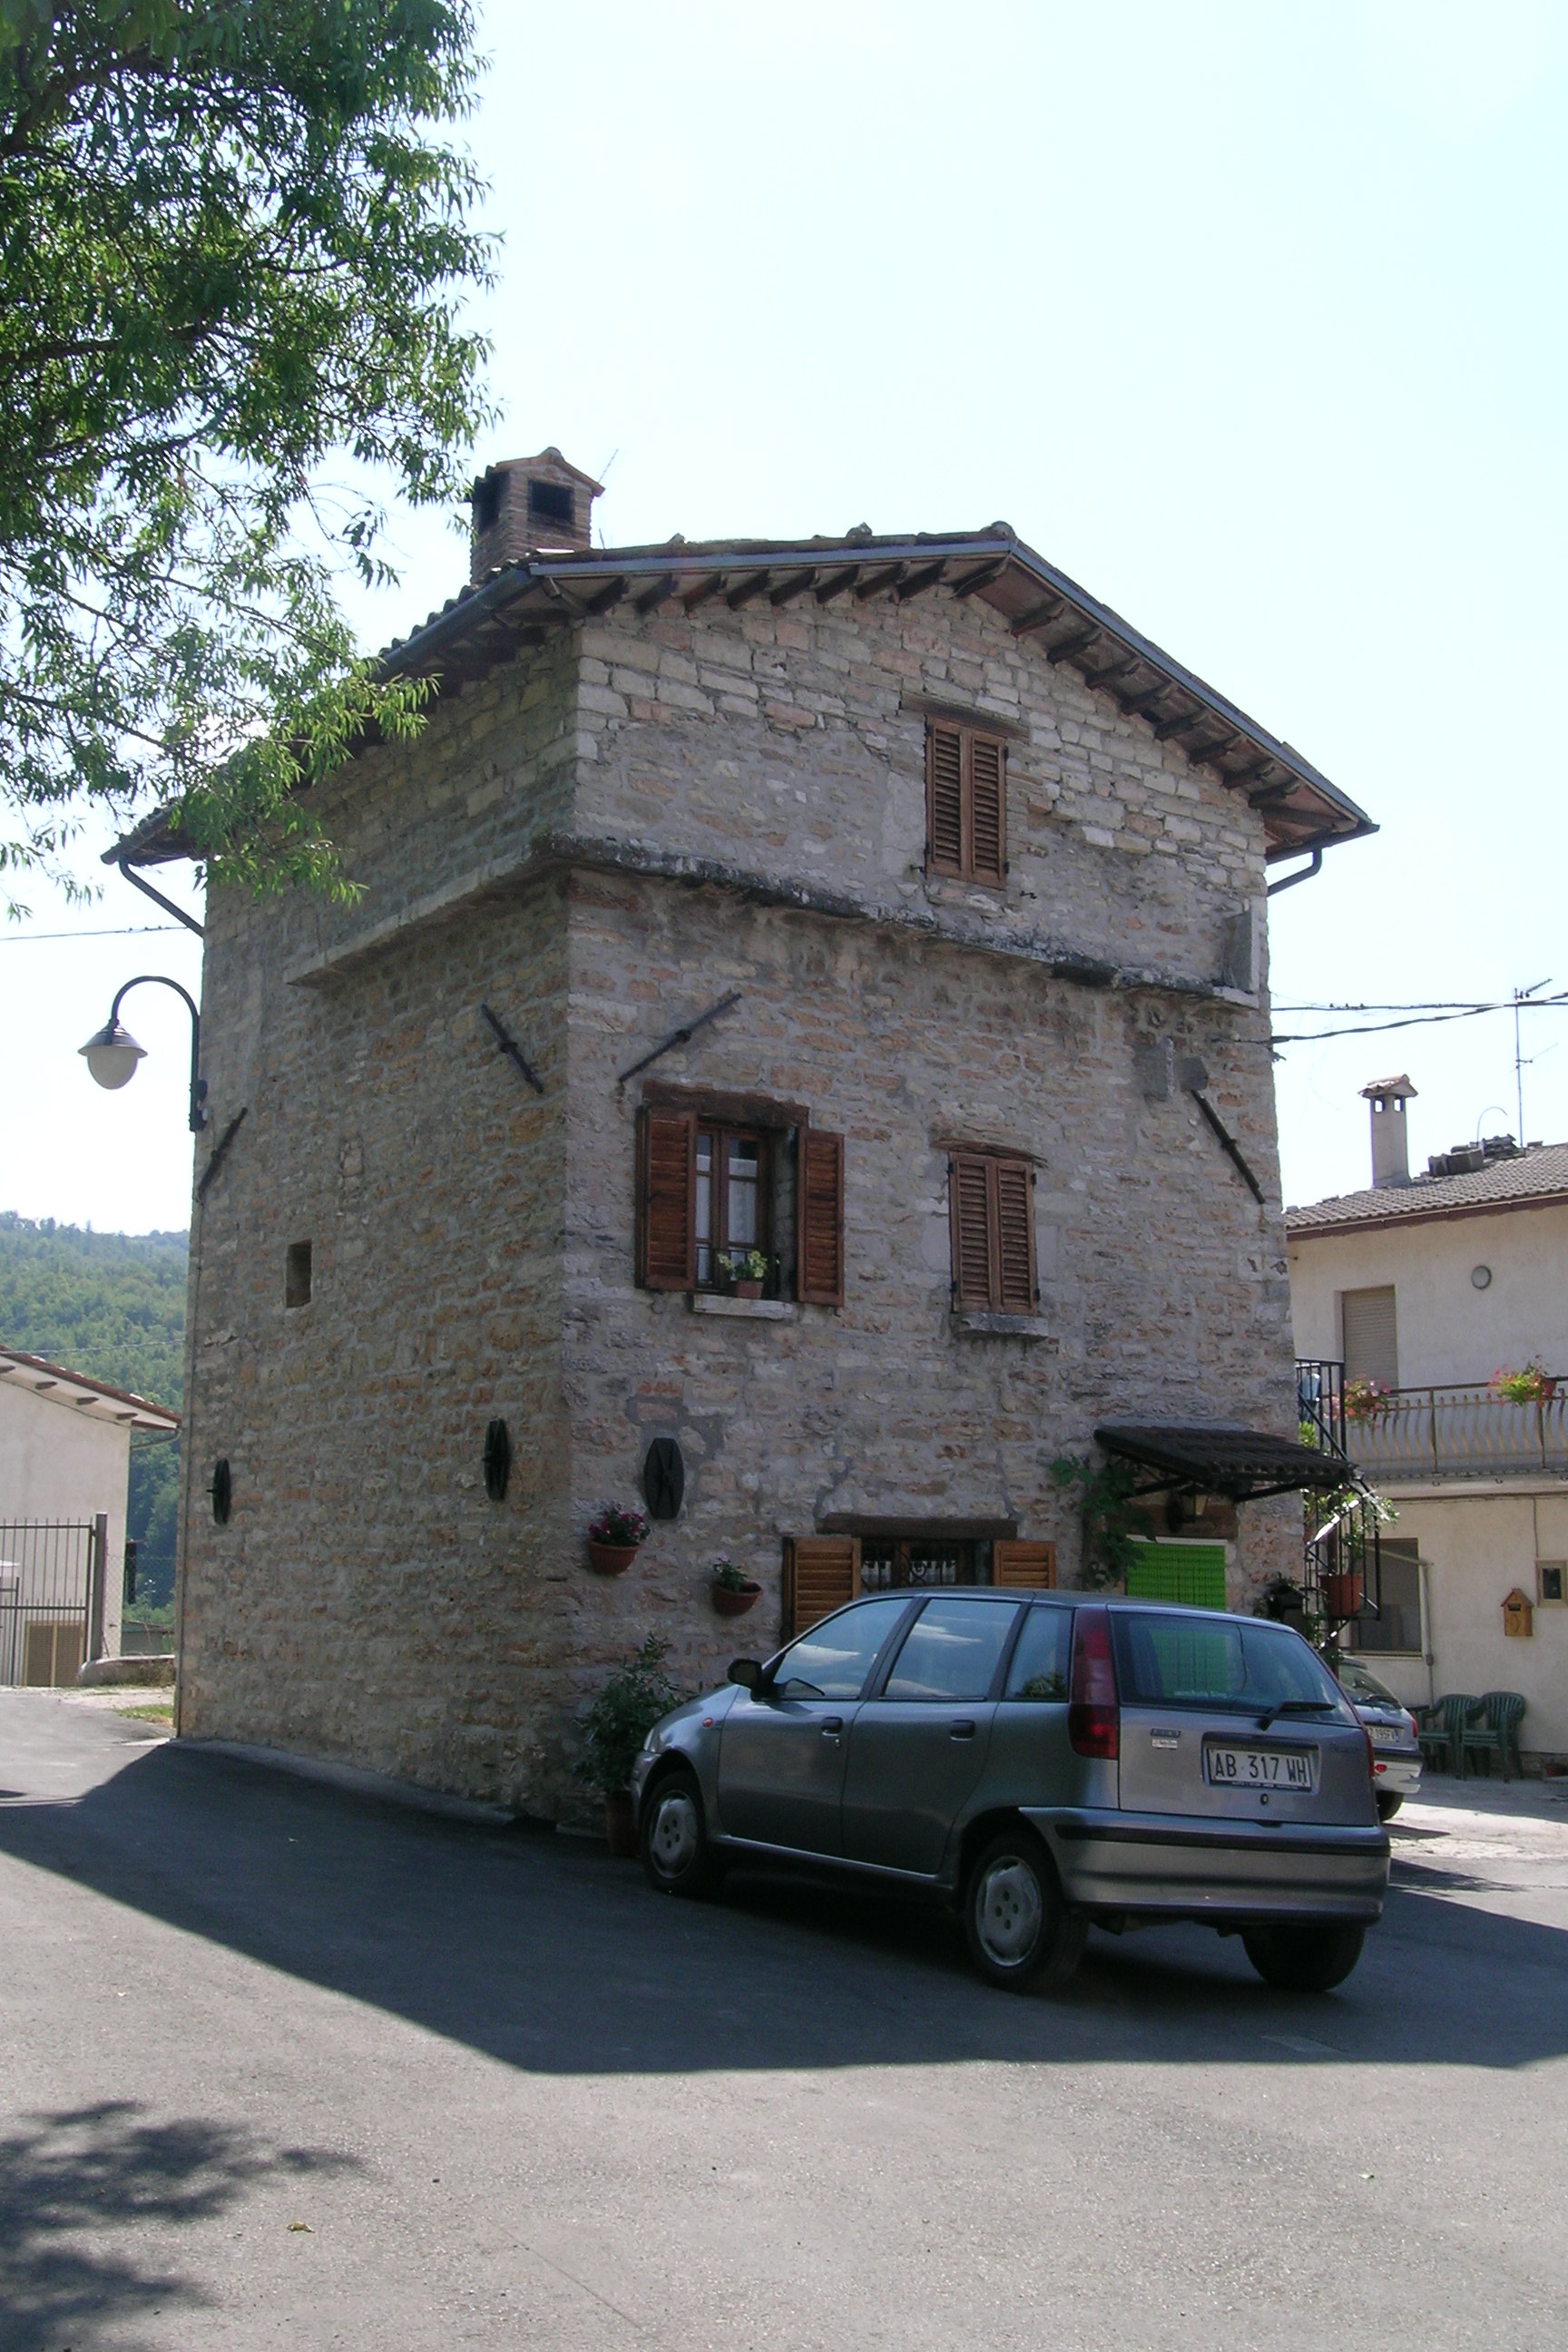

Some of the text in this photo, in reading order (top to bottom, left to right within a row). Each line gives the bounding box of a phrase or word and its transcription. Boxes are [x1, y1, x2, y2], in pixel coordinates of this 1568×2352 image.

[1215, 1752, 1308, 1783] AB 317 WH
